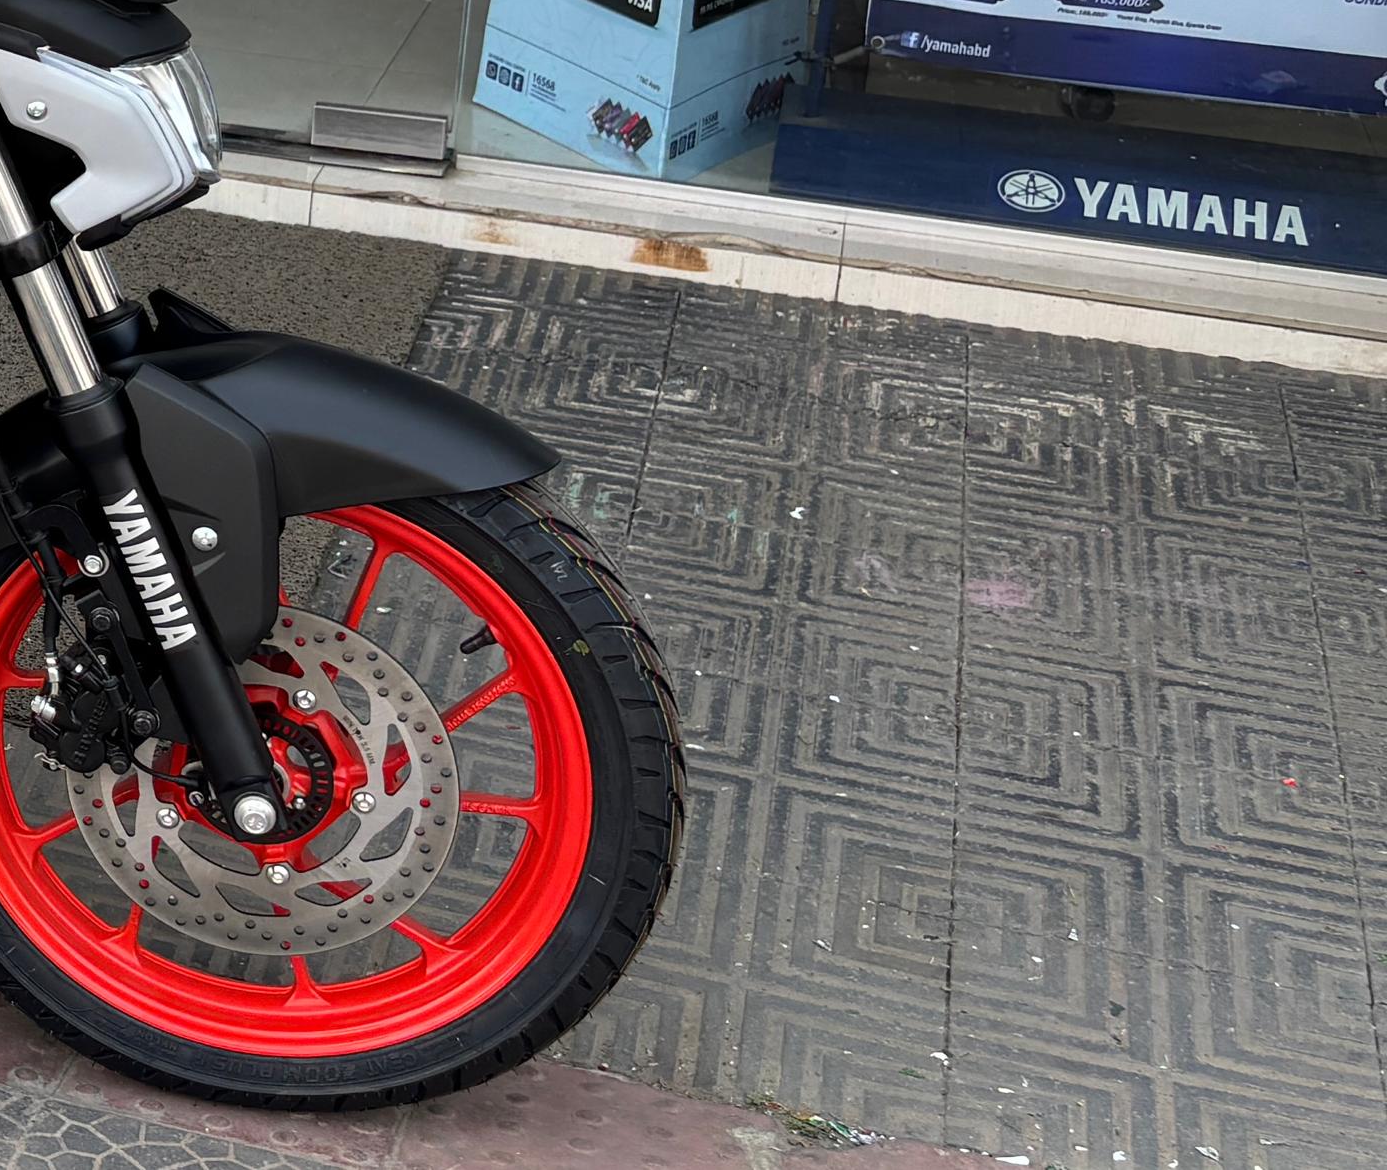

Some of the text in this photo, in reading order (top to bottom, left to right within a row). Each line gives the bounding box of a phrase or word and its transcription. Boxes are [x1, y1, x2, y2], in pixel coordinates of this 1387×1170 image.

[921, 34, 991, 68] /yamahabd
[531, 72, 556, 91] 16568
[1072, 176, 1309, 247] YAMAHA
[103, 488, 197, 651] YAMAHA
